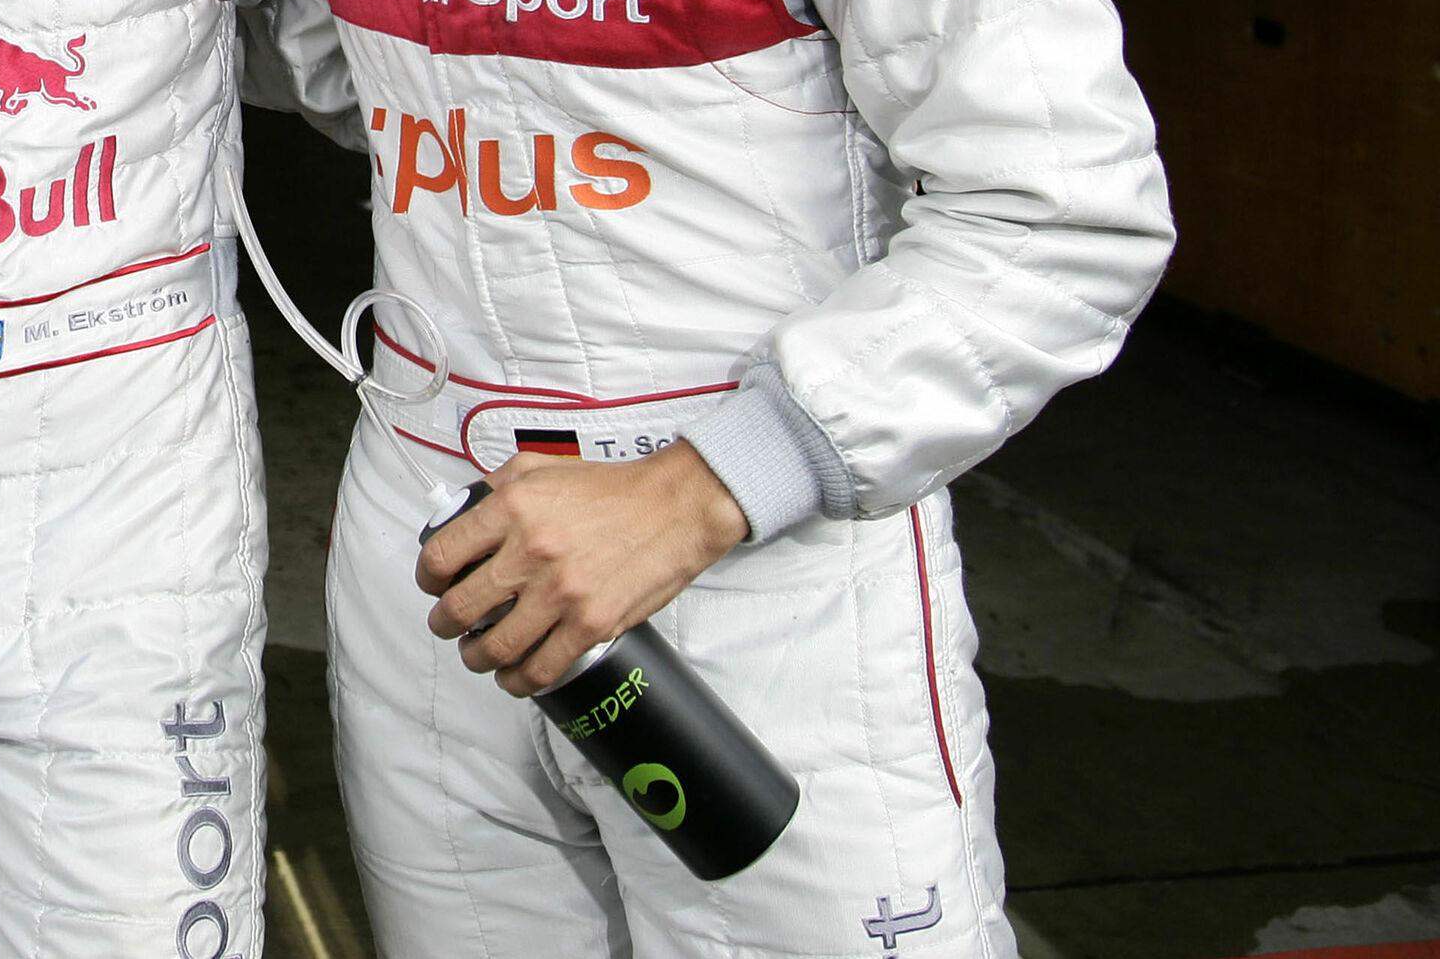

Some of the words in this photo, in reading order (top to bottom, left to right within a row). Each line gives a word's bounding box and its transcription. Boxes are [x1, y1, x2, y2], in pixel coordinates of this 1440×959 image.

[24, 320, 60, 344] M.
[68, 287, 189, 332] Ekström
[595, 439, 627, 459] T.
